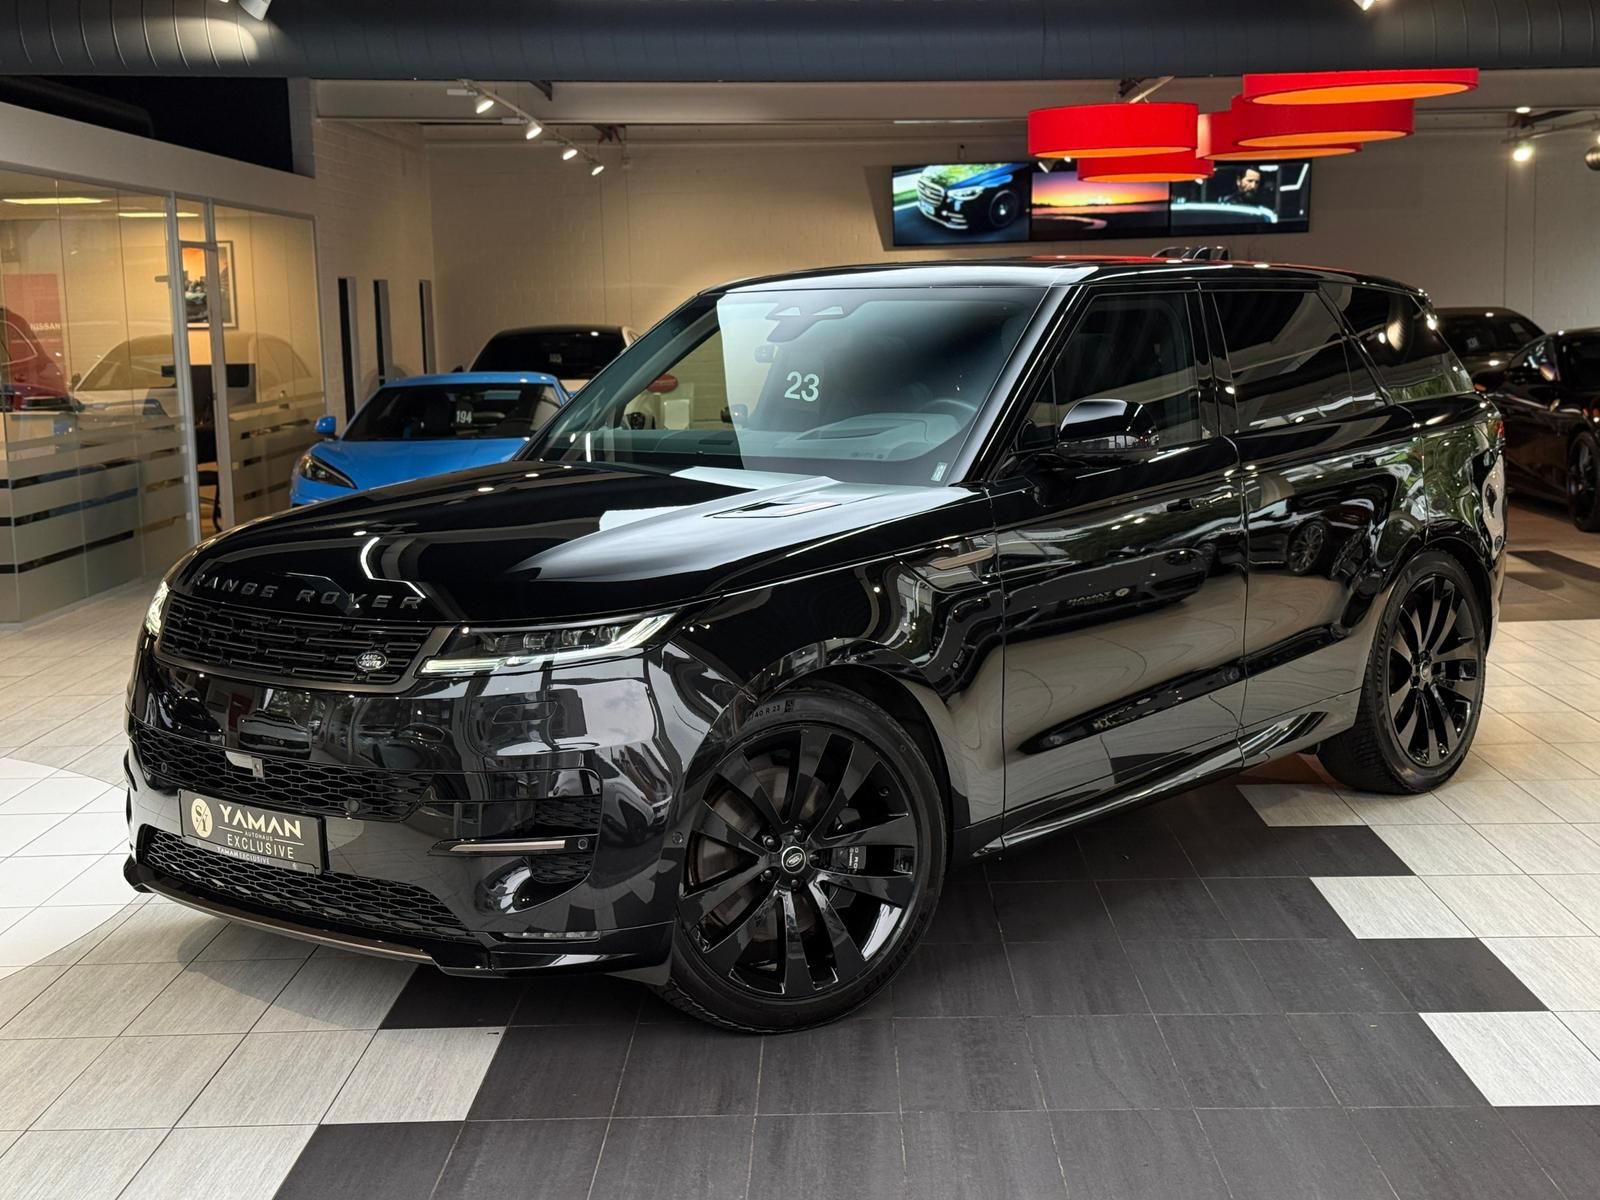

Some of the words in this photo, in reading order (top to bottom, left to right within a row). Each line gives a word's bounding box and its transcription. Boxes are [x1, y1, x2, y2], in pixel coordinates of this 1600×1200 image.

[31, 322, 61, 331] NISSAN
[784, 371, 820, 402] 23
[456, 410, 472, 424] 194
[190, 574, 279, 598] RANGE
[296, 590, 423, 610] ROVER
[219, 804, 302, 840] YAMAN
[227, 834, 294, 860] EXCLUSIVE
[244, 831, 273, 841] AUTOHAUS
